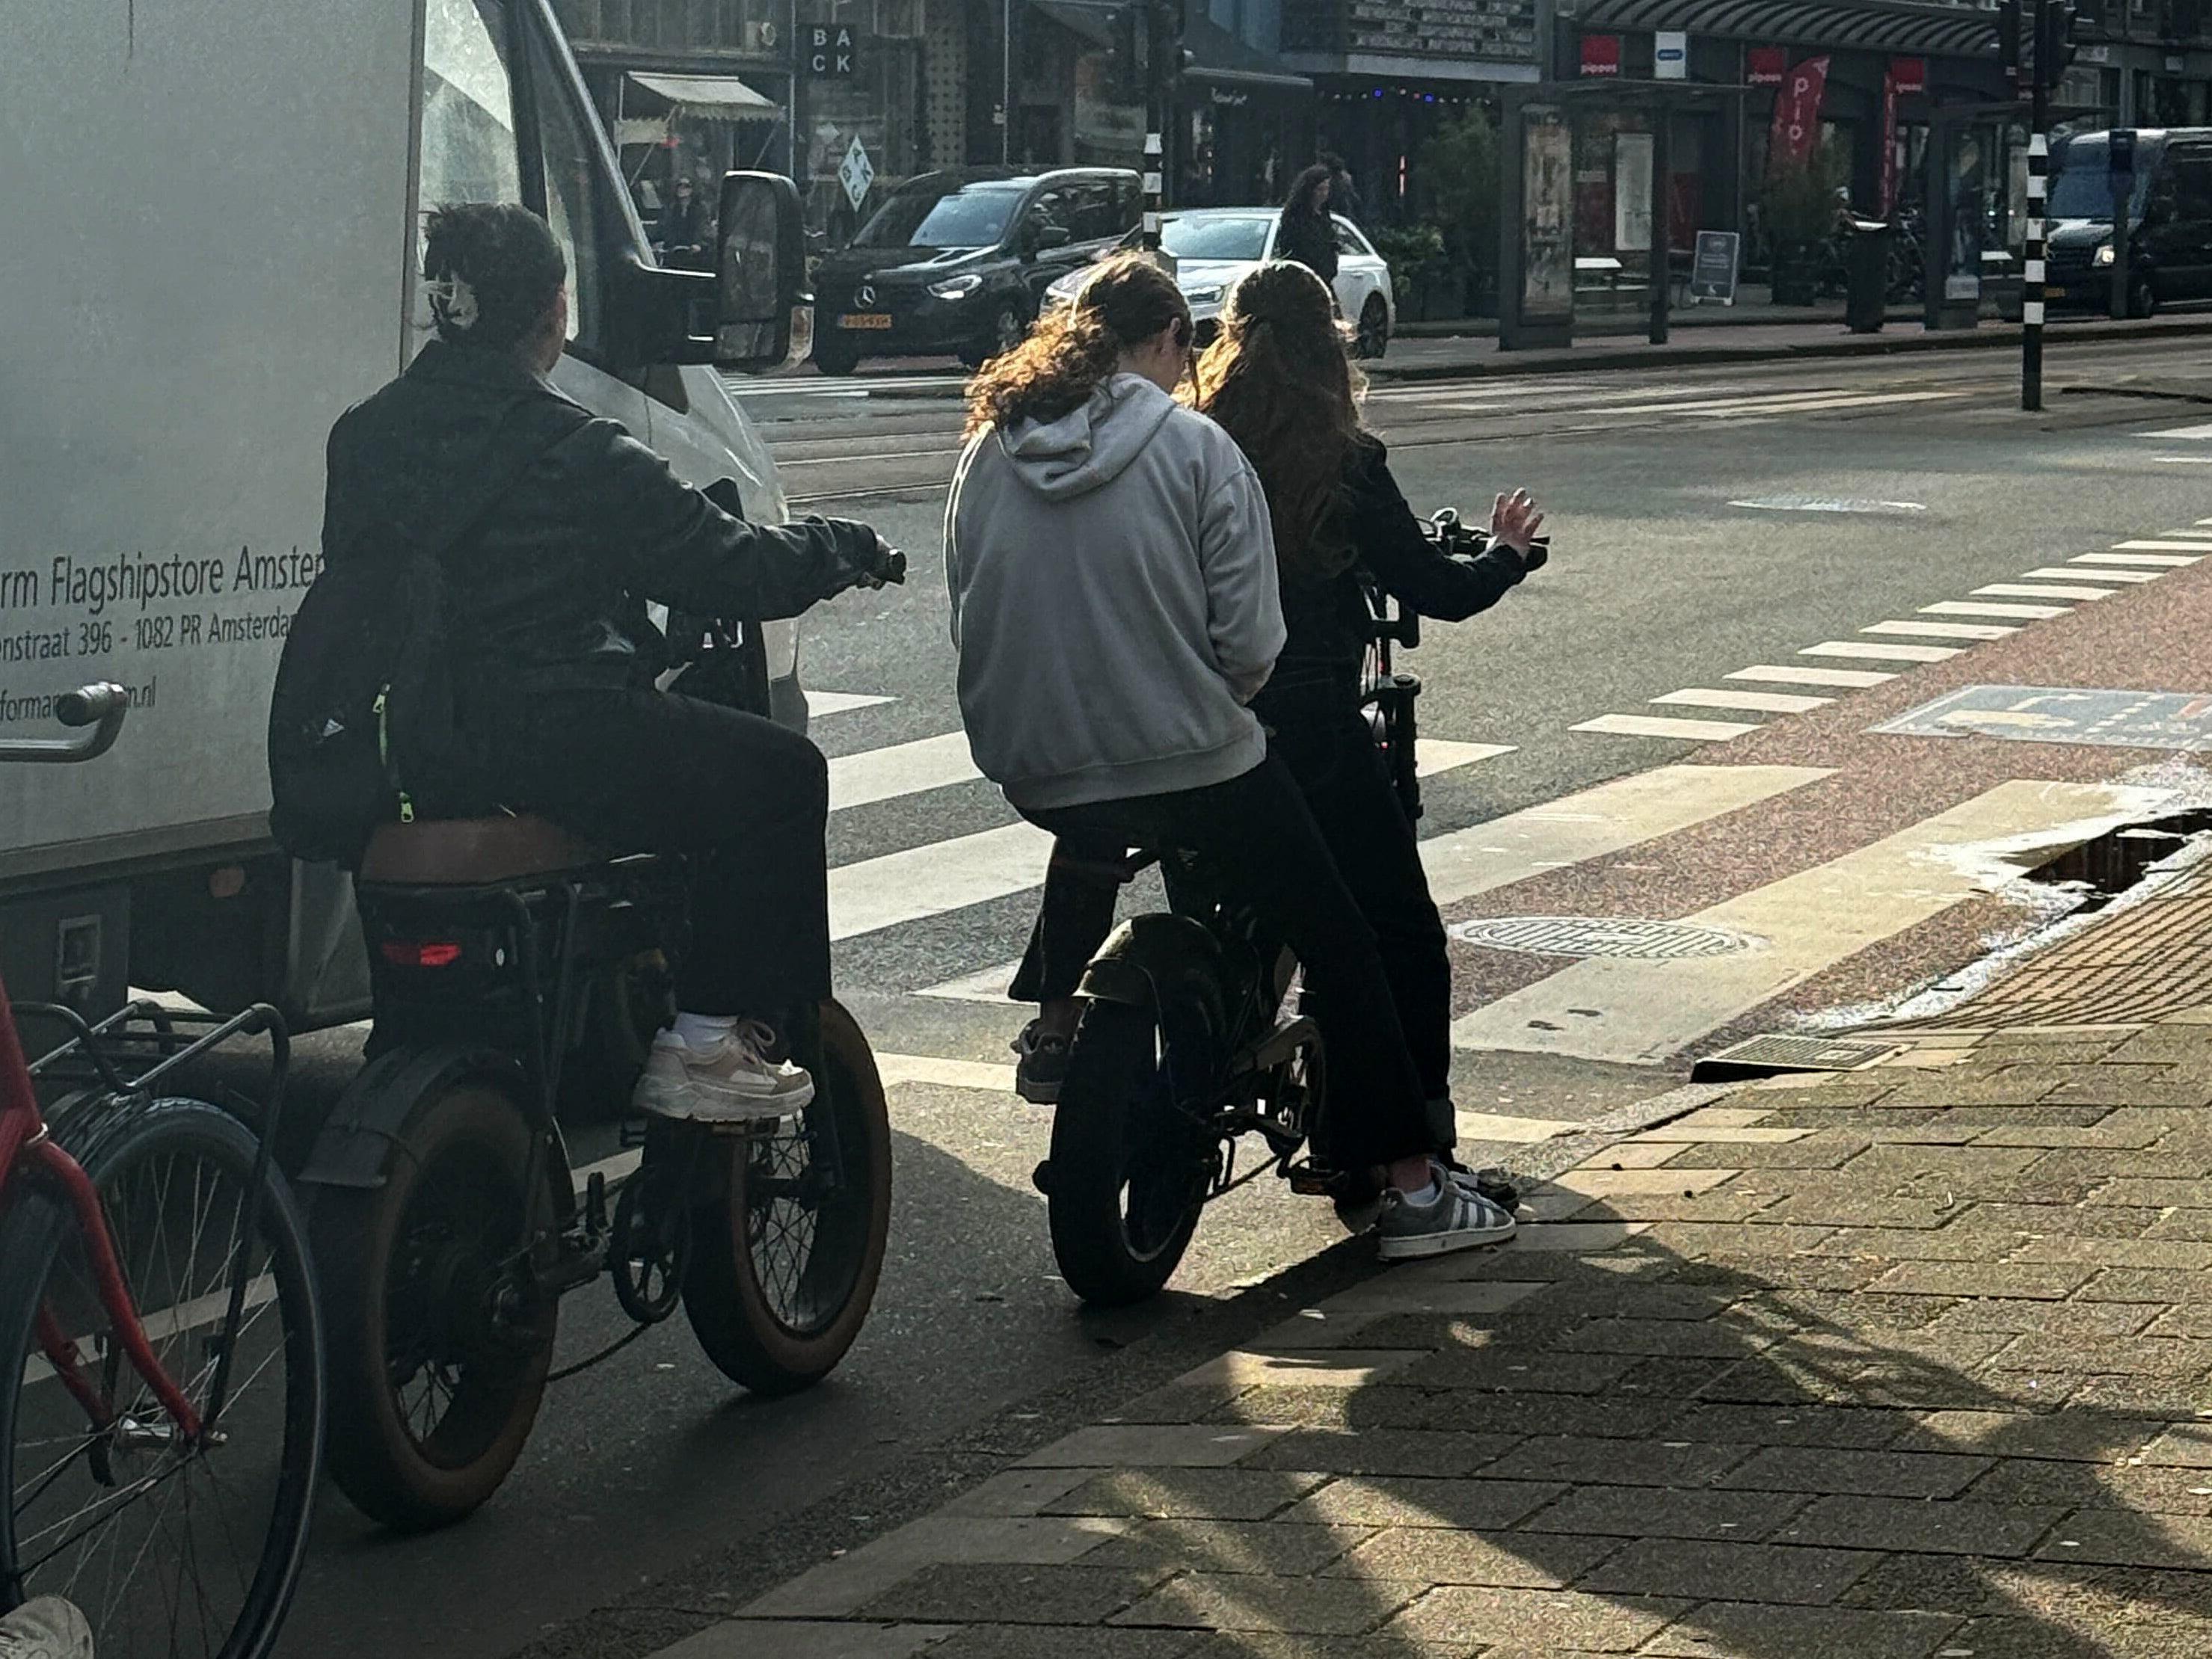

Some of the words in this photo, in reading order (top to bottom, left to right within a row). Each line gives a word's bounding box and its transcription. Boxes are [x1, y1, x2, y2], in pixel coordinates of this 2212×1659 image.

[51, 550, 224, 615] Flagshipstore
[233, 544, 325, 591] Amster
[0, 627, 71, 662] nstraat
[78, 621, 112, 656] 396
[135, 616, 173, 650] 1082
[180, 614, 202, 644] PR
[207, 606, 293, 644] Amsterda
